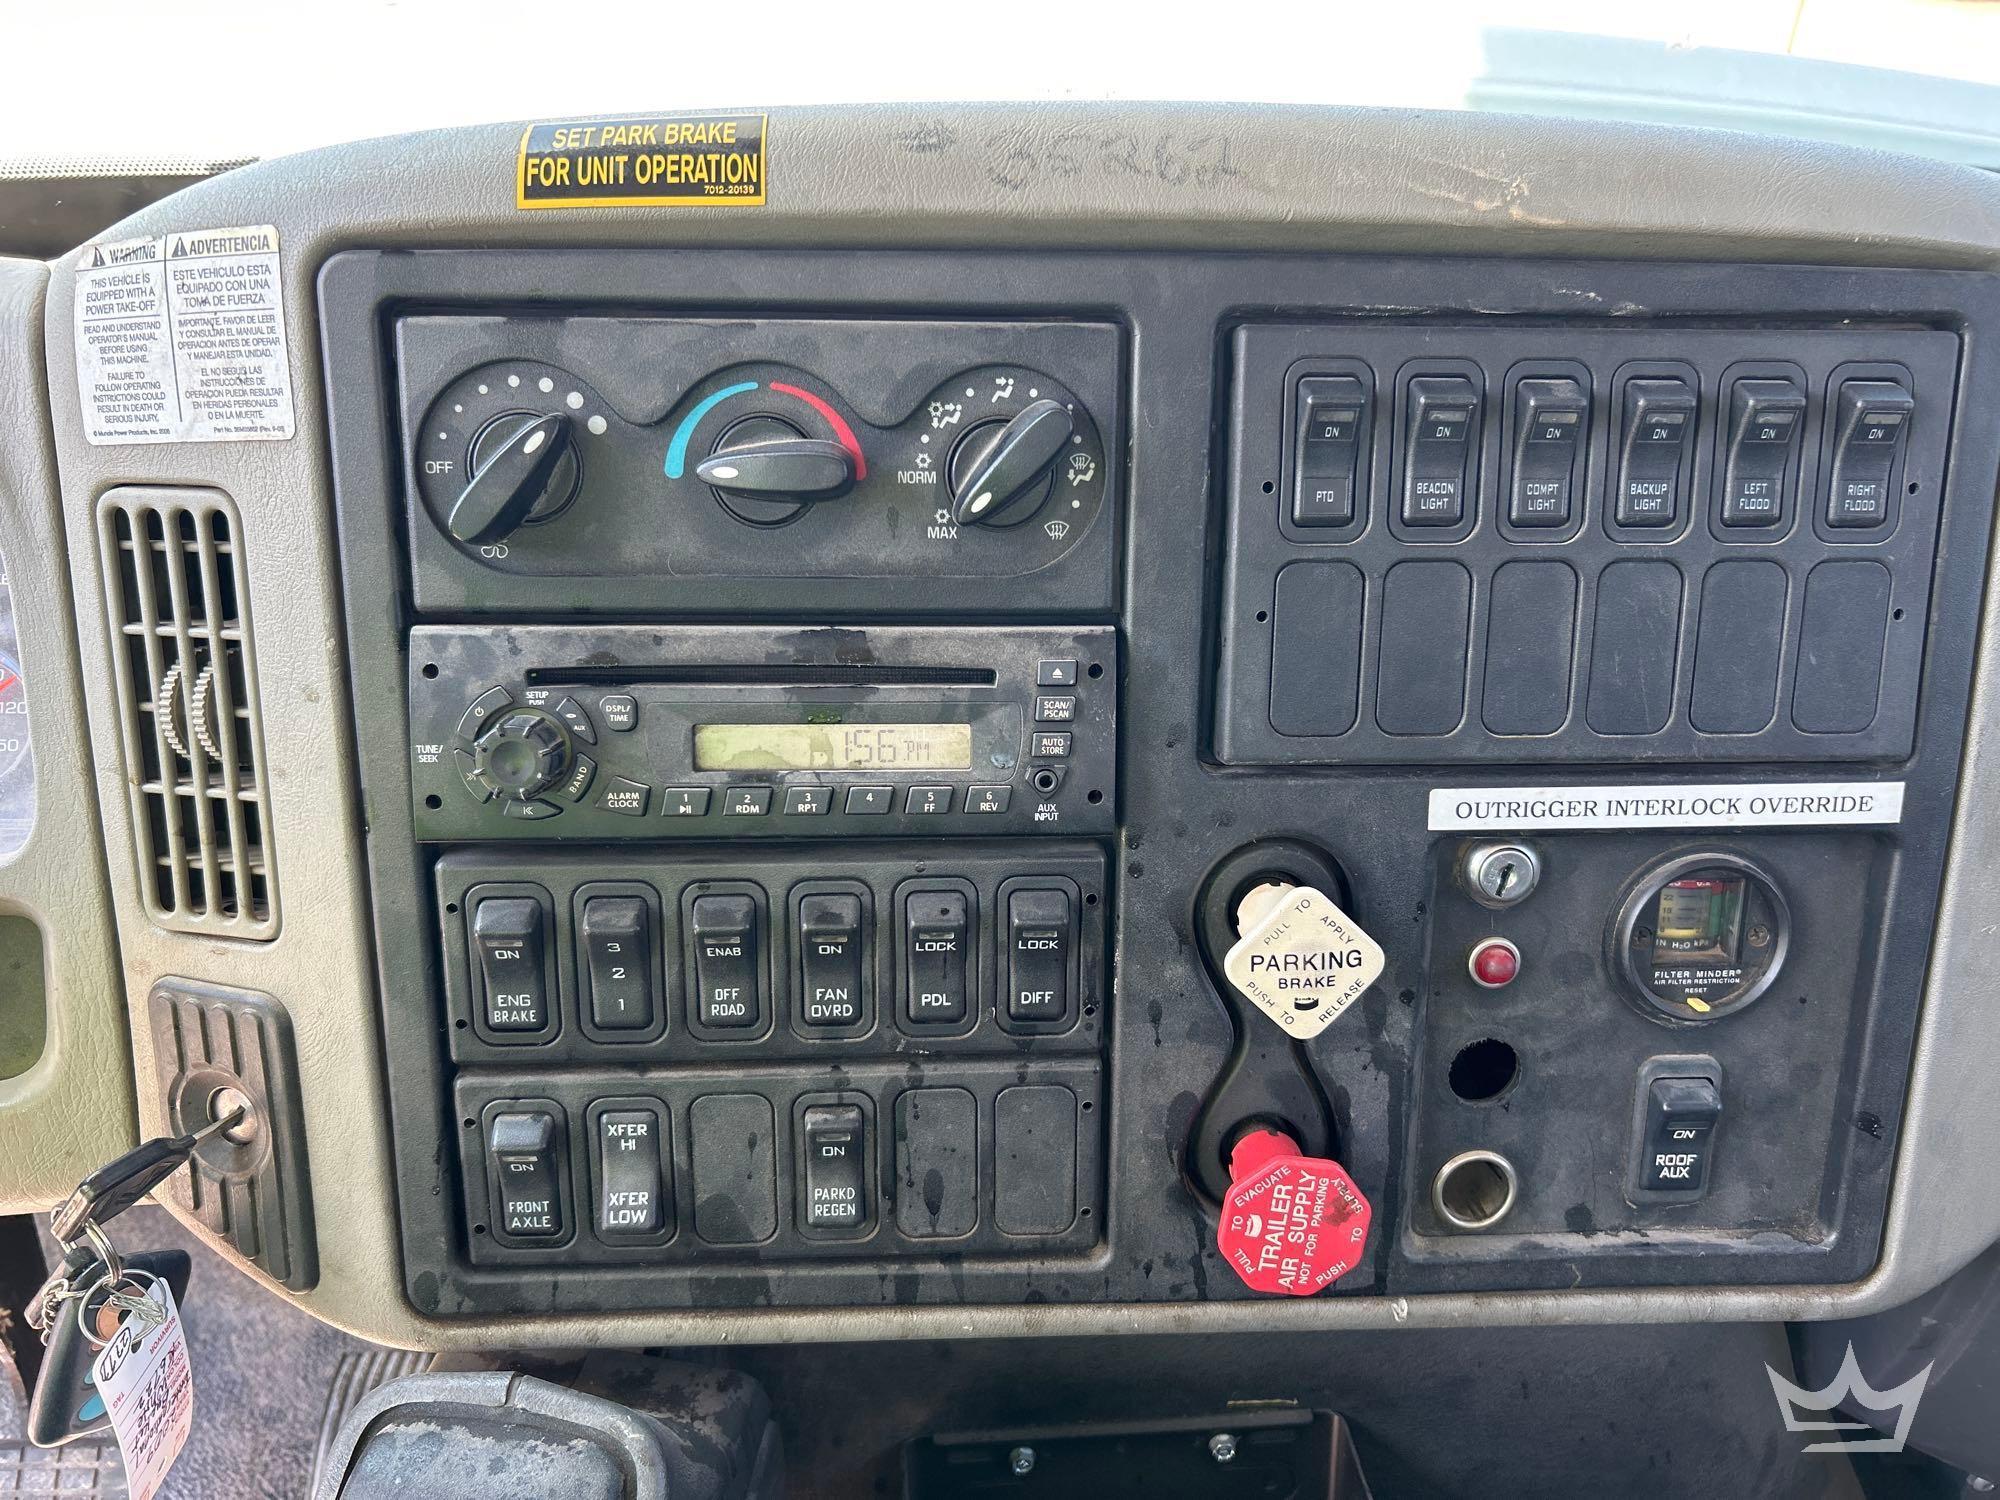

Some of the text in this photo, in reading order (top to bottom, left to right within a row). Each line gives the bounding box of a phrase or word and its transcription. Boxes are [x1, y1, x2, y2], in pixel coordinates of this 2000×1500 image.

[552, 122, 737, 148] SET PARK BRAKE
[527, 153, 758, 186] FOR UNIT OPERATION
[704, 185, 755, 194] 7012-20139
[190, 234, 270, 255] ADVERTENCIA
[173, 264, 271, 280] ESTE VEHICULO ESTA
[91, 273, 150, 289] THIS VEHICLE IS
[177, 279, 270, 294] EQUIPADO CON UNA
[87, 286, 155, 302] EQUIPPED WITH A
[184, 293, 265, 307] TOMA DE FUERZA
[86, 300, 155, 315] POWER TAKE-OFF
[84, 321, 160, 334] READ AND UNDERSTAND
[95, 381, 161, 392] FOLLOW OPERATING
[1325, 426, 1339, 437] ON
[1436, 427, 1451, 437] ON
[1546, 428, 1561, 439] ON
[1653, 428, 1668, 439] ON
[1760, 429, 1776, 439] ON
[1868, 429, 1884, 439] ON
[425, 461, 453, 474] OFF
[897, 471, 936, 484] NORM
[1416, 482, 1454, 494] BEACON
[1526, 484, 1559, 495] COMPT
[1630, 483, 1668, 495] BACKUP
[1744, 483, 1768, 494] LEFT
[1848, 484, 1876, 496] RIGHT
[1316, 490, 1334, 503] PTO
[1421, 498, 1449, 510] LIGHT
[1527, 499, 1556, 511] LIGHT
[1634, 499, 1661, 510] LIGHT
[1739, 499, 1770, 510] FLOOD
[1844, 500, 1875, 511] FLOOD
[928, 527, 957, 539] MAX
[526, 691, 549, 699] SETUP
[606, 705, 631, 713] DSPL/
[1044, 701, 1070, 709] SCAN/
[610, 714, 629, 722] TIME
[1044, 710, 1069, 718] PSCAN
[1042, 738, 1064, 746] AUTO
[416, 745, 444, 754] TUNE/
[904, 740, 929, 761] PM
[1041, 747, 1064, 755] STORE
[419, 754, 439, 762] SEEK
[570, 766, 587, 793] BAND
[607, 792, 640, 800] ALARM
[683, 793, 689, 802] 1
[744, 794, 751, 803] 2
[805, 793, 811, 802] 3
[866, 793, 873, 802] 4
[928, 792, 934, 801] 5
[986, 792, 992, 800] 6
[608, 800, 639, 808] CLOCK
[735, 804, 760, 814] RDM
[797, 803, 817, 812] RPT
[924, 804, 935, 812] FF
[980, 803, 998, 811] REV
[1037, 804, 1057, 812] AUX
[1455, 795, 1874, 819] OUTRIGGER INTERLOCK OVERRIDE
[1034, 813, 1059, 821] INPUT
[1264, 899, 1356, 946] PULL TO APPLY
[607, 943, 621, 952] 3
[818, 945, 842, 954] ON
[915, 942, 956, 951] LOCK
[1018, 940, 1059, 950] LOCK
[495, 950, 520, 959] ON
[706, 947, 742, 956] ENAB
[1251, 950, 1362, 972] PARKING
[612, 967, 626, 979] 2
[1278, 975, 1336, 989] BRAKE
[715, 988, 740, 1001] OFF
[816, 989, 848, 1000] FAN
[921, 993, 951, 1006] PDL
[1021, 991, 1054, 1004] DIFF
[497, 995, 531, 1007] ENG
[618, 999, 624, 1011] 1
[1246, 978, 1365, 1025] PUSH TO RELEASE
[711, 1003, 745, 1016] ROAD
[811, 1004, 853, 1017] OVRD
[494, 1010, 536, 1023] BRAKE
[607, 1123, 648, 1137] XFER
[1673, 1130, 1695, 1138] ON
[620, 1139, 636, 1151] HI
[822, 1146, 845, 1156] ON
[1656, 1154, 1697, 1166] ROOF
[510, 1163, 534, 1172] ON
[1659, 1167, 1689, 1178] AUX
[609, 1191, 649, 1206] XFER
[814, 1187, 856, 1201] PARKD
[509, 1200, 550, 1213] FRONT
[814, 1203, 856, 1217] REGEN
[511, 1215, 552, 1228] AXLE
[609, 1209, 647, 1224] LOW
[1231, 1165, 1291, 1274] PULL TO EVACUATE
[1258, 1184, 1294, 1272] TRAILER
[1278, 1170, 1316, 1289] AIR SUPPLY
[1298, 1177, 1329, 1284] NOT FOR PARKING
[1315, 1177, 1363, 1285] PUSH TO SUPPLY
[149, 1316, 176, 1354] SURVIVOR
[166, 1352, 185, 1380] COLOR
[112, 1392, 125, 1408] TAG
